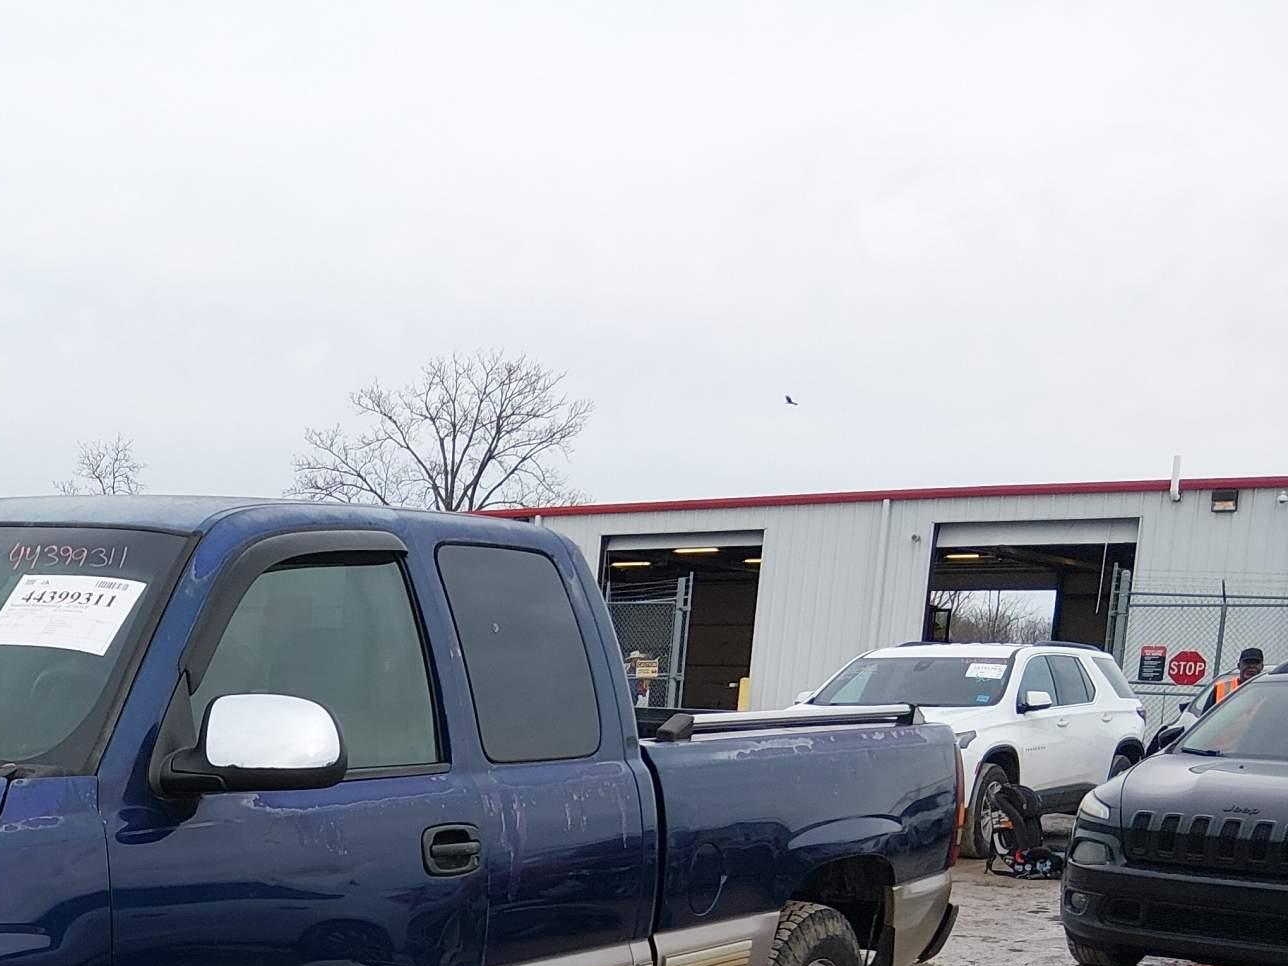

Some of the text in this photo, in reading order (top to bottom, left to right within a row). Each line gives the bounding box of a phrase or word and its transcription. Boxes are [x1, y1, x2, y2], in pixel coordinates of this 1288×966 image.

[9, 543, 129, 570] 44399311
[21, 590, 116, 608] 44399311
[1169, 661, 1205, 676] STOP
